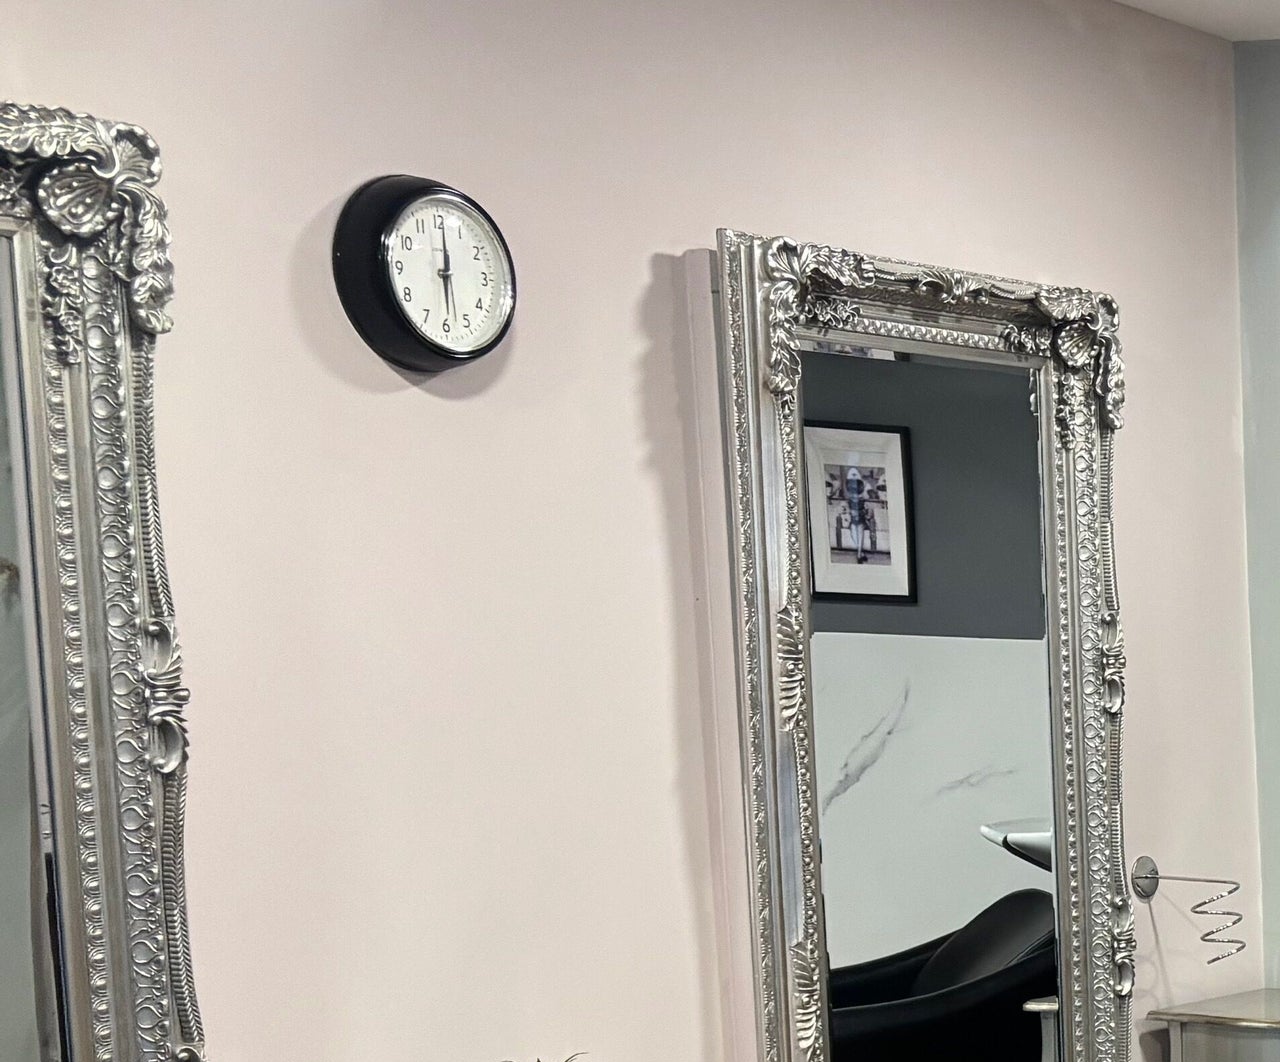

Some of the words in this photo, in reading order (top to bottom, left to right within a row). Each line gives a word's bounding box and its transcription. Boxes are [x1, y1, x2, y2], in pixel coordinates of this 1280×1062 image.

[416, 218, 425, 234] 11
[433, 214, 444, 230] 12
[401, 235, 413, 251] 10
[473, 246, 481, 260] 2
[395, 260, 404, 275] 9
[481, 272, 489, 287] 3
[403, 287, 412, 302] 8
[475, 298, 483, 311] 4
[423, 309, 430, 324] 7
[463, 314, 471, 328] 5
[442, 318, 450, 333] 6
